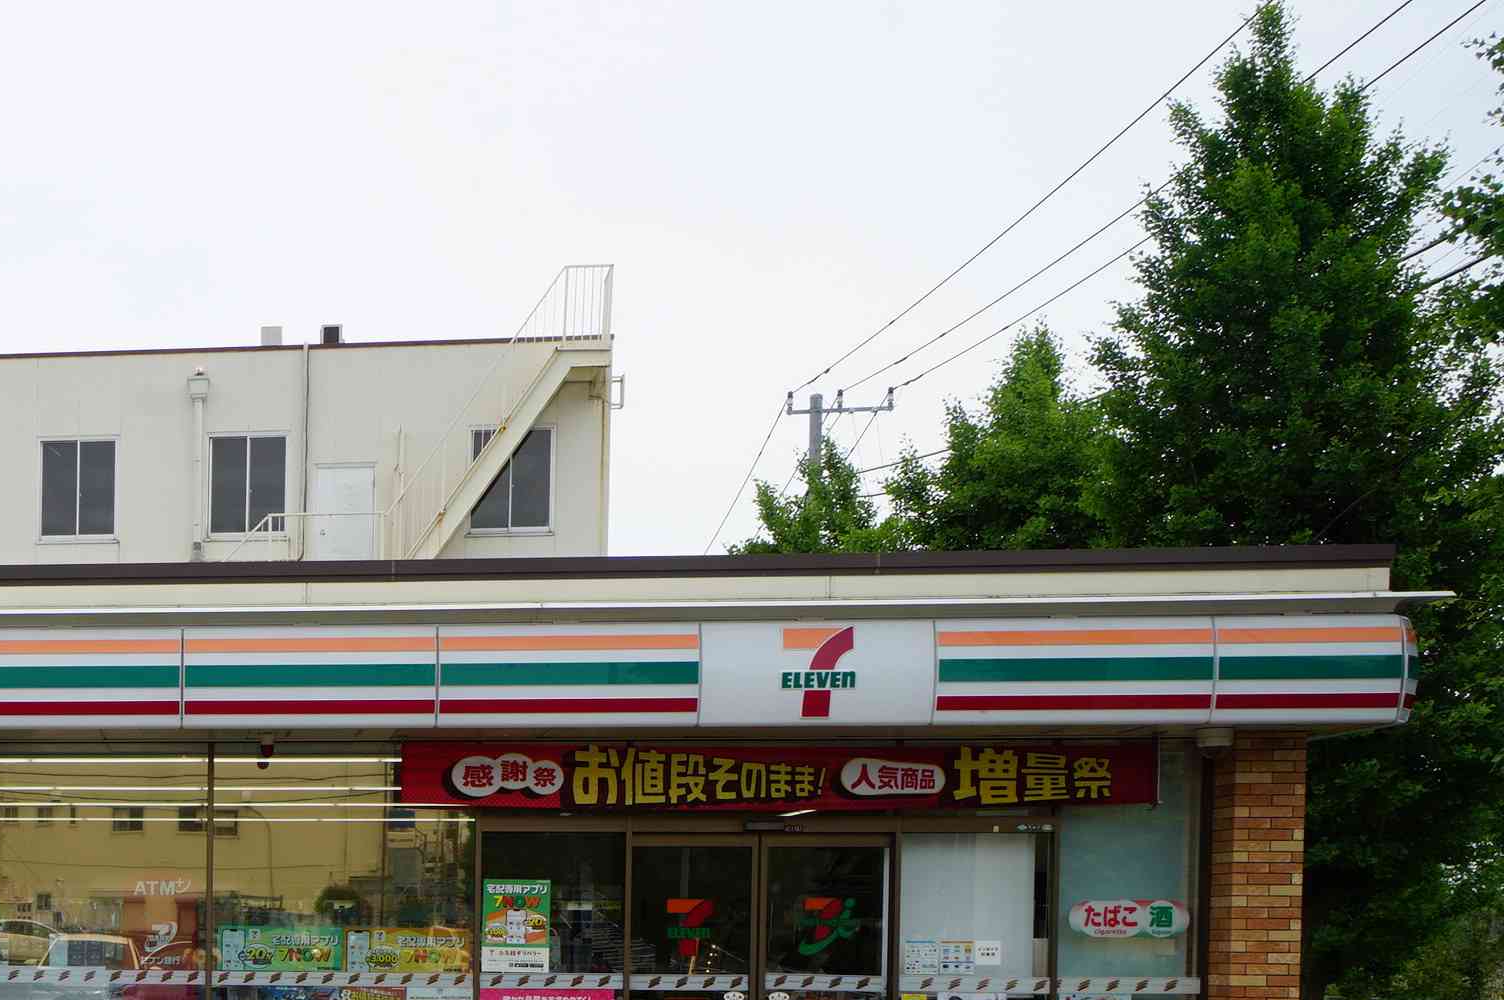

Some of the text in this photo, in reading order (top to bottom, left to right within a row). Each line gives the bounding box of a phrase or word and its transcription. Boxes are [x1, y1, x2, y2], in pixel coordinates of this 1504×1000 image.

[462, 759, 558, 789] 感謝祭
[851, 764, 937, 791] 人気商品
[953, 745, 1113, 805] 増量祭
[1084, 906, 1138, 928] たばこ
[1149, 906, 1174, 928] 酒
